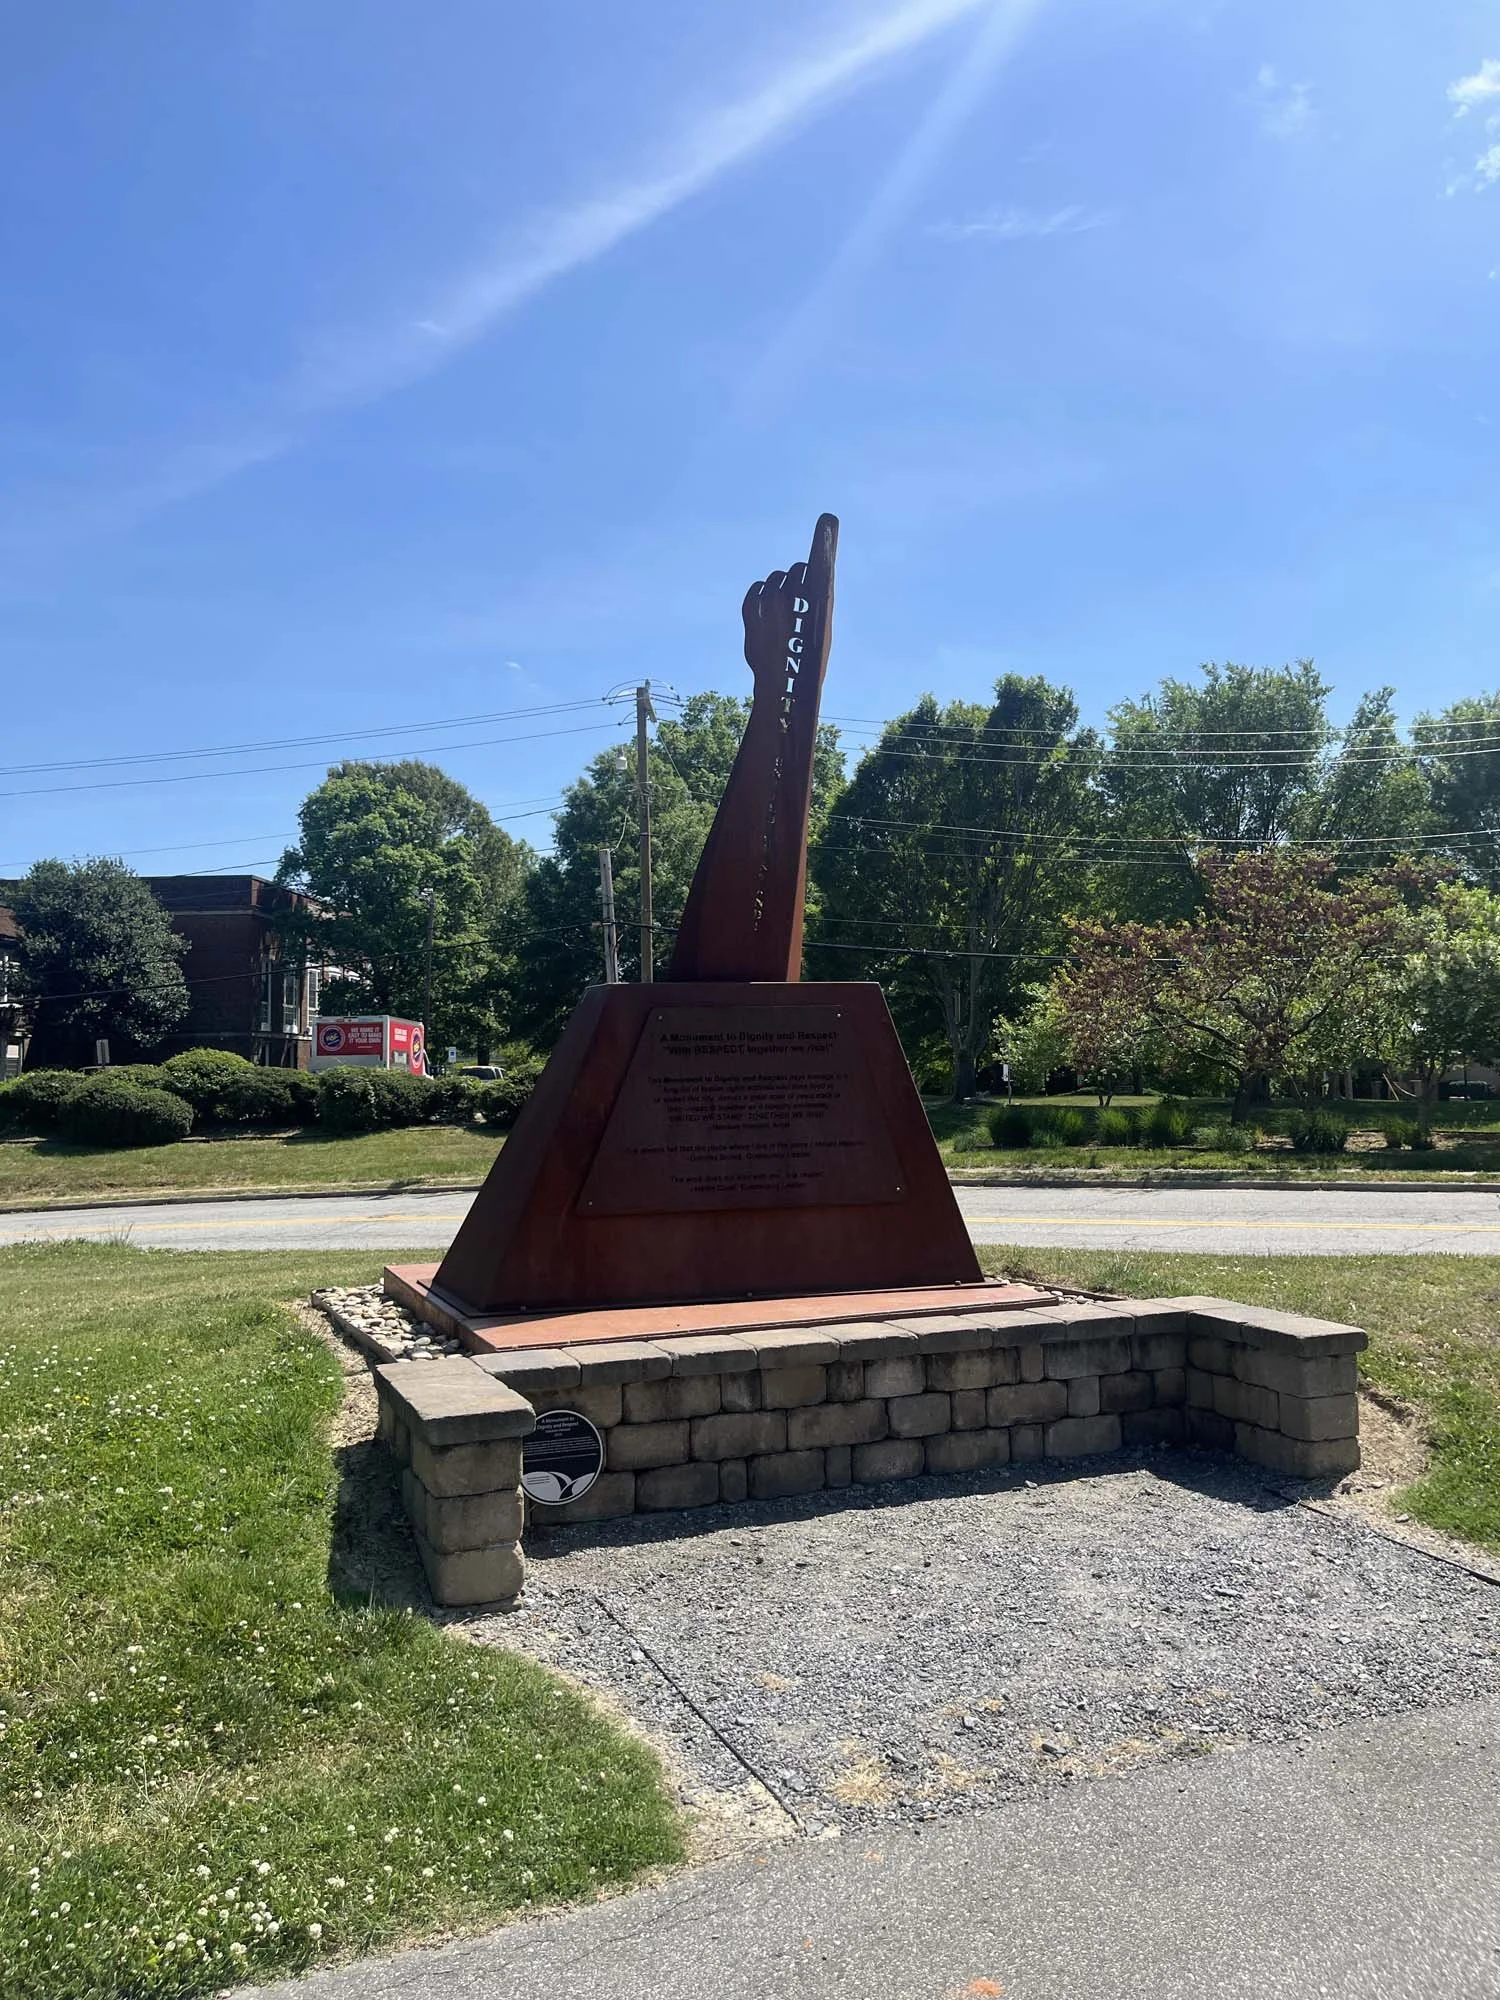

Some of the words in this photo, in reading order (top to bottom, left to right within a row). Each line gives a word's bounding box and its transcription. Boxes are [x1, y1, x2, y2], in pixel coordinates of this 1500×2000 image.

[778, 596, 809, 733] DIGNITY
[660, 1032, 669, 1043] A
[670, 1032, 723, 1042] Monument
[726, 1032, 736, 1041] to
[739, 1031, 774, 1043] Dignity
[776, 1031, 795, 1041] and
[797, 1031, 838, 1042] Respect
[747, 1044, 788, 1056] together
